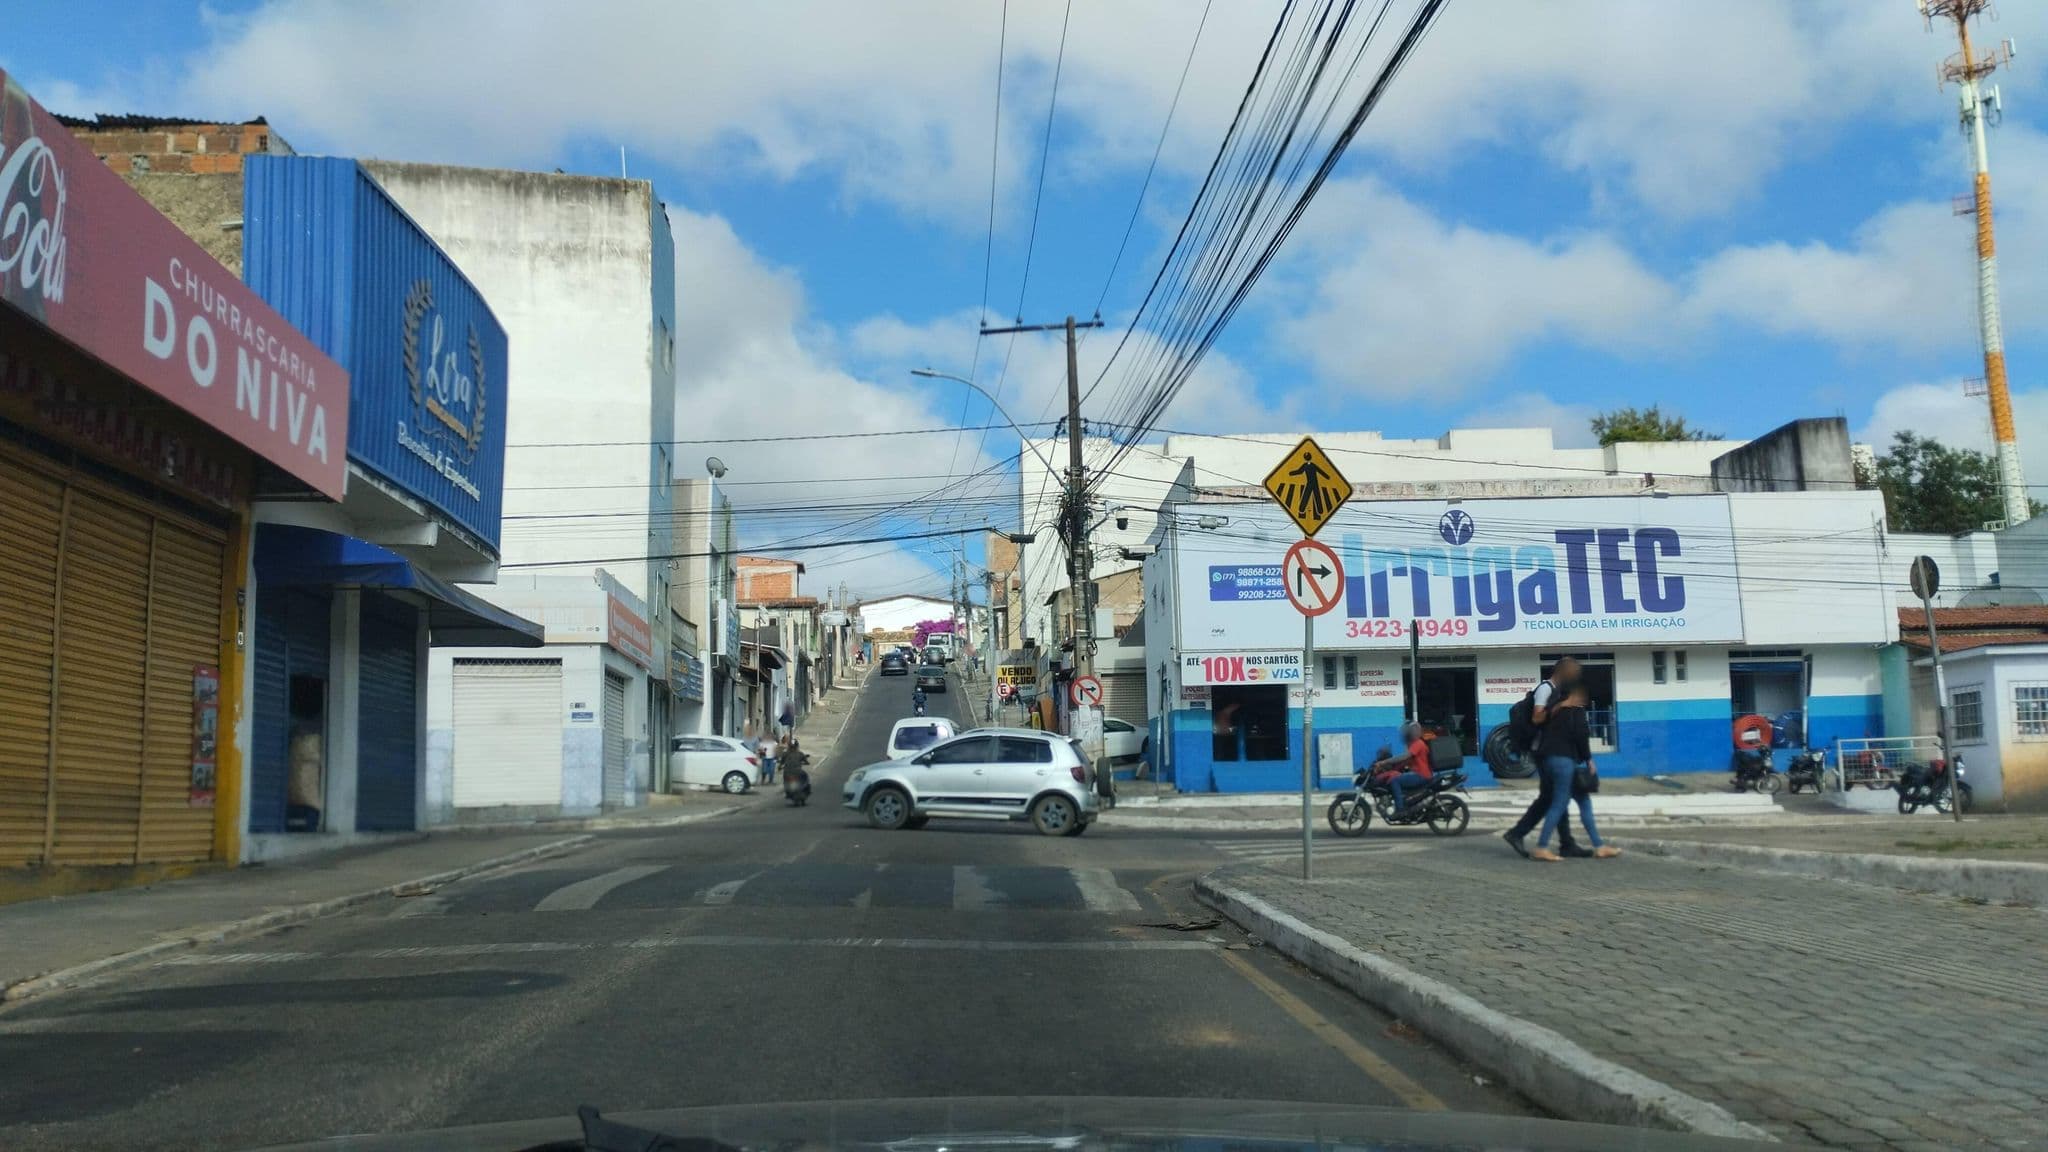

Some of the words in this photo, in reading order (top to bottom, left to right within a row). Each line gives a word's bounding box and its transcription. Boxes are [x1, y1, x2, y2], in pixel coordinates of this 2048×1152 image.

[169, 257, 316, 392] CHURRASCARIA
[143, 276, 217, 387] DO
[236, 346, 328, 465] NIVA
[1222, 573, 1236, 581] (77)
[1236, 578, 1284, 586] 98871-258
[1345, 619, 1468, 638] 3423-4949
[1523, 619, 1598, 630] TECNOLOGIA
[1601, 619, 1618, 628] EM
[1621, 616, 1686, 629] IRRIGAÇÃO
[1001, 666, 1032, 676] VENDO
[1186, 657, 1200, 666] ATÉ
[1201, 656, 1245, 682] 10X
[1246, 656, 1262, 665] NOS
[1263, 654, 1299, 664] CARTÕES
[1272, 668, 1299, 679] VISA
